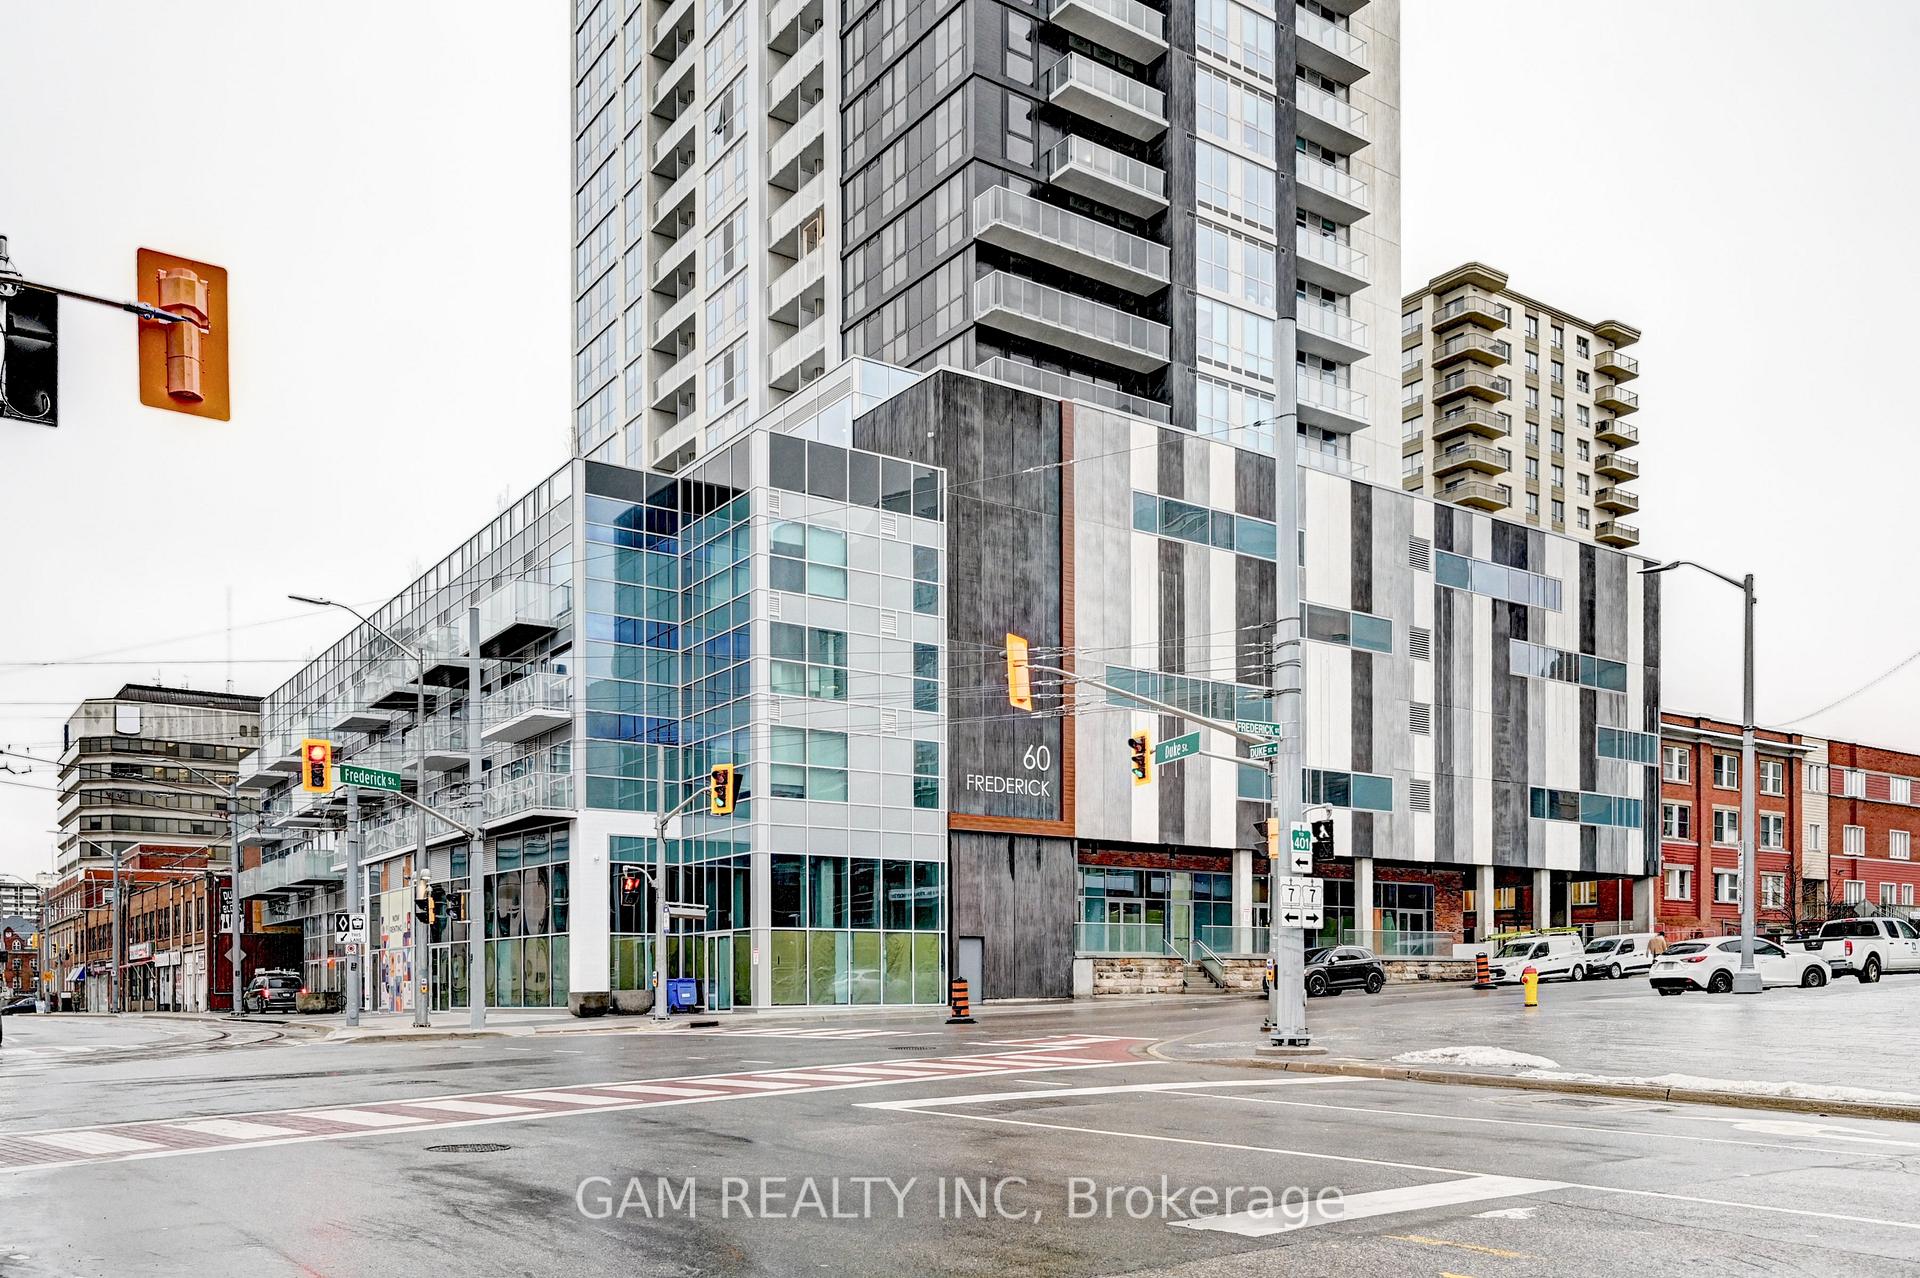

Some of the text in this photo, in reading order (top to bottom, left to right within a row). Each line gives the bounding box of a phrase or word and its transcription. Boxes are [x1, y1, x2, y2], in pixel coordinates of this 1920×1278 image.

[1237, 722, 1274, 734] FREDERICK
[1023, 744, 1051, 771] 60
[1165, 743, 1181, 759] Duke
[1250, 747, 1268, 758] DUKE
[344, 768, 397, 787] Frederick St.
[966, 774, 1051, 798] FREDERICK
[1294, 837, 1309, 850] 401
[1288, 888, 1295, 902] 7
[1309, 889, 1316, 903] 7
